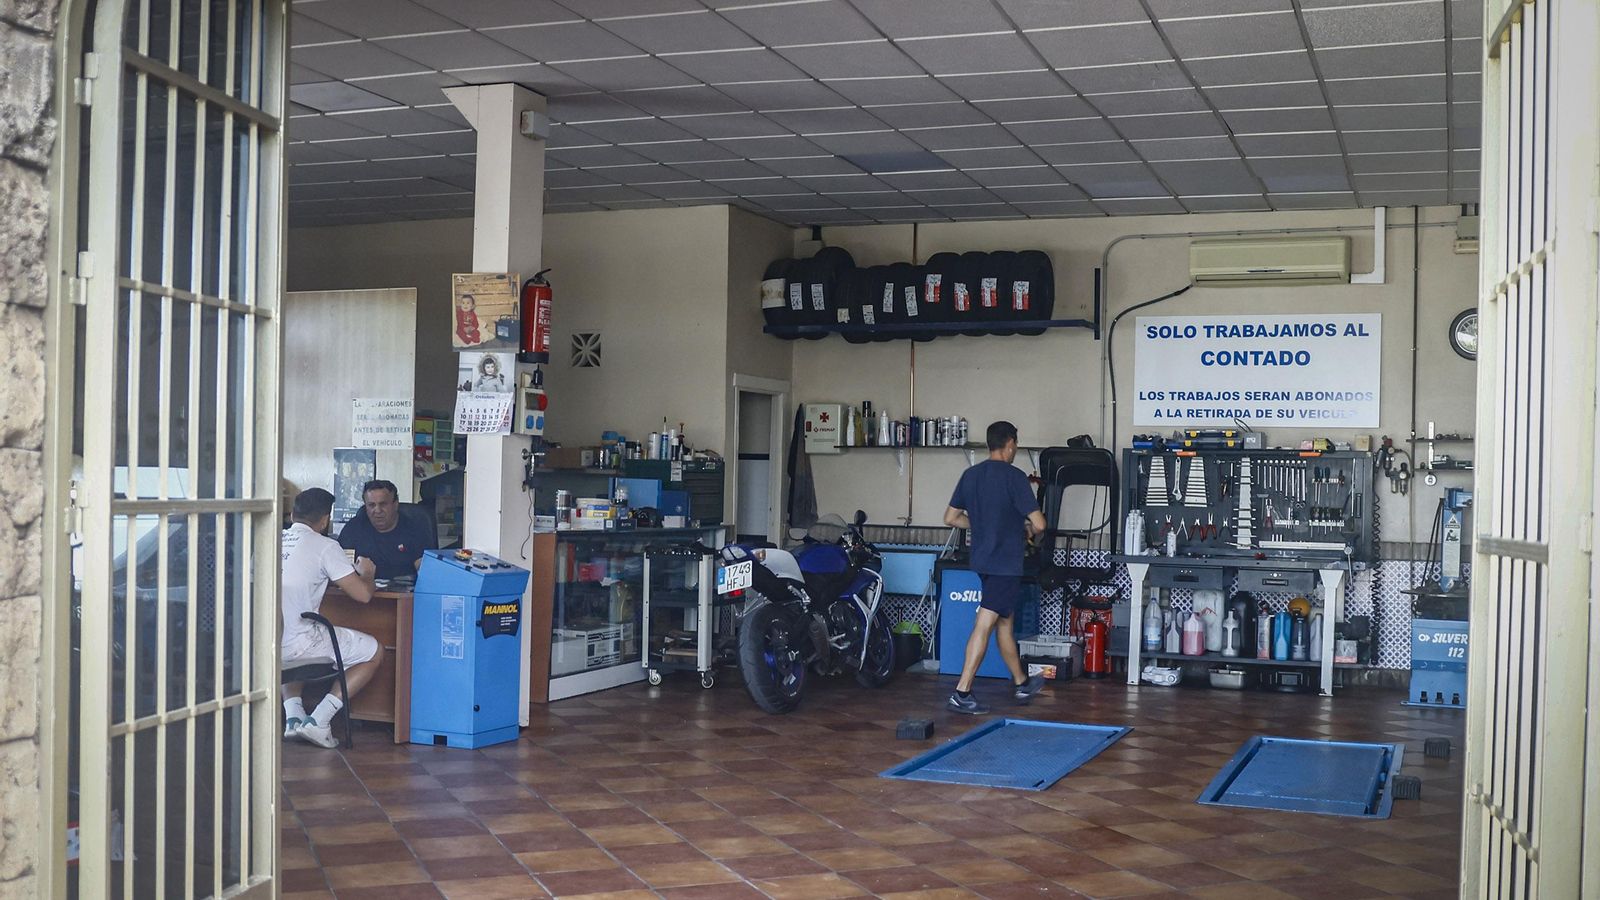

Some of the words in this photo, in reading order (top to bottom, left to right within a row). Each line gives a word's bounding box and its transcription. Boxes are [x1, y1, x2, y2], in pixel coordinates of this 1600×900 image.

[1146, 325, 1197, 339] SOLO
[1203, 323, 1337, 338] TRABAJAMOS
[1343, 323, 1370, 337] AL
[1200, 350, 1311, 366] CONTADO
[1139, 391, 1165, 401] LOS
[1169, 391, 1240, 401] TRABAJOS
[1244, 391, 1291, 401] SERAN
[1295, 391, 1374, 402] ABONADOS
[1154, 409, 1162, 418] A
[1166, 409, 1183, 418] LA
[1187, 409, 1251, 418] RETIRADA
[1256, 409, 1273, 418] DE
[1277, 409, 1295, 419] SU
[728, 562, 751, 578] 1743
[726, 575, 746, 590] HFJ
[962, 590, 982, 602] SIL
[484, 604, 518, 615] MANNOL
[1432, 632, 1468, 645] SILVER
[1448, 646, 1465, 658] 112
